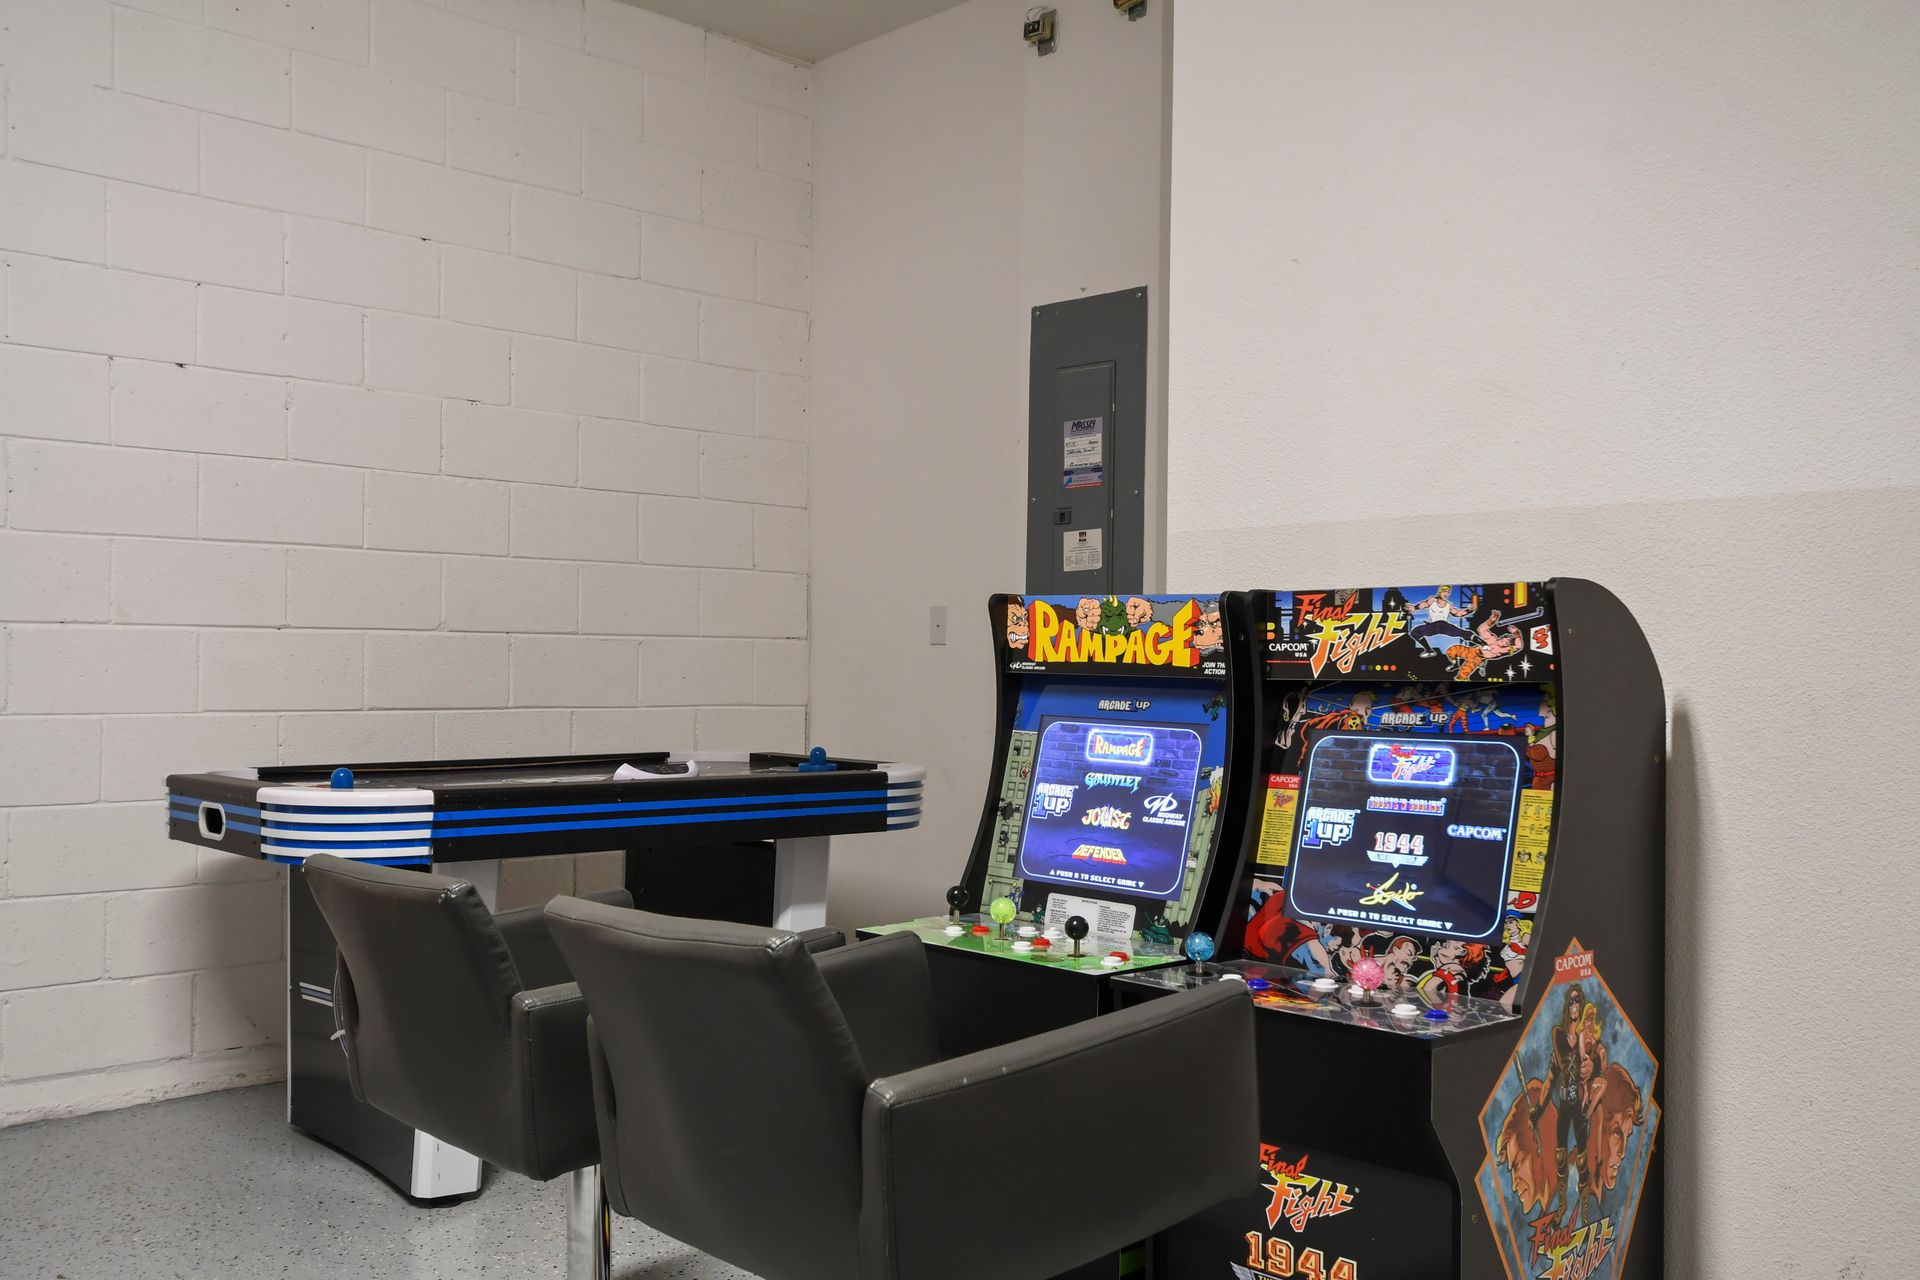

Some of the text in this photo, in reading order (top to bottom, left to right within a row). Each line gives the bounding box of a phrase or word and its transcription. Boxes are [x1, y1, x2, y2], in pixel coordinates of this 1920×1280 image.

[1072, 419, 1096, 431] MASSEY
[1295, 591, 1358, 627] Final
[1028, 598, 1200, 667] RAMPAGE
[1269, 643, 1307, 651] CAPCOM
[1305, 612, 1406, 679] Fight
[1093, 735, 1146, 757] RAMPAGE
[1085, 772, 1142, 794] GAUNTLET
[1270, 775, 1300, 784] CAPCOM
[1036, 783, 1075, 798] ARCADE
[1082, 804, 1132, 830] JOUST
[1306, 807, 1354, 824] ARCADE
[1374, 831, 1424, 855] 1944
[1447, 824, 1503, 841] CAPCOM
[1072, 844, 1127, 864] DEFENDER
[1056, 870, 1073, 878] PUSH
[1090, 875, 1116, 884] SELECT
[1117, 878, 1137, 887] GAME
[1337, 908, 1359, 918] PUSH
[1368, 912, 1380, 920] TO
[1381, 914, 1415, 925] SELECT
[1416, 918, 1443, 928] GAME
[1556, 953, 1592, 971] CAPCOM
[1580, 968, 1592, 977] USA
[1259, 1143, 1309, 1179] Final
[1260, 1164, 1354, 1232] Fight
[1528, 1200, 1579, 1271] Final
[1245, 1231, 1358, 1280] 1944
